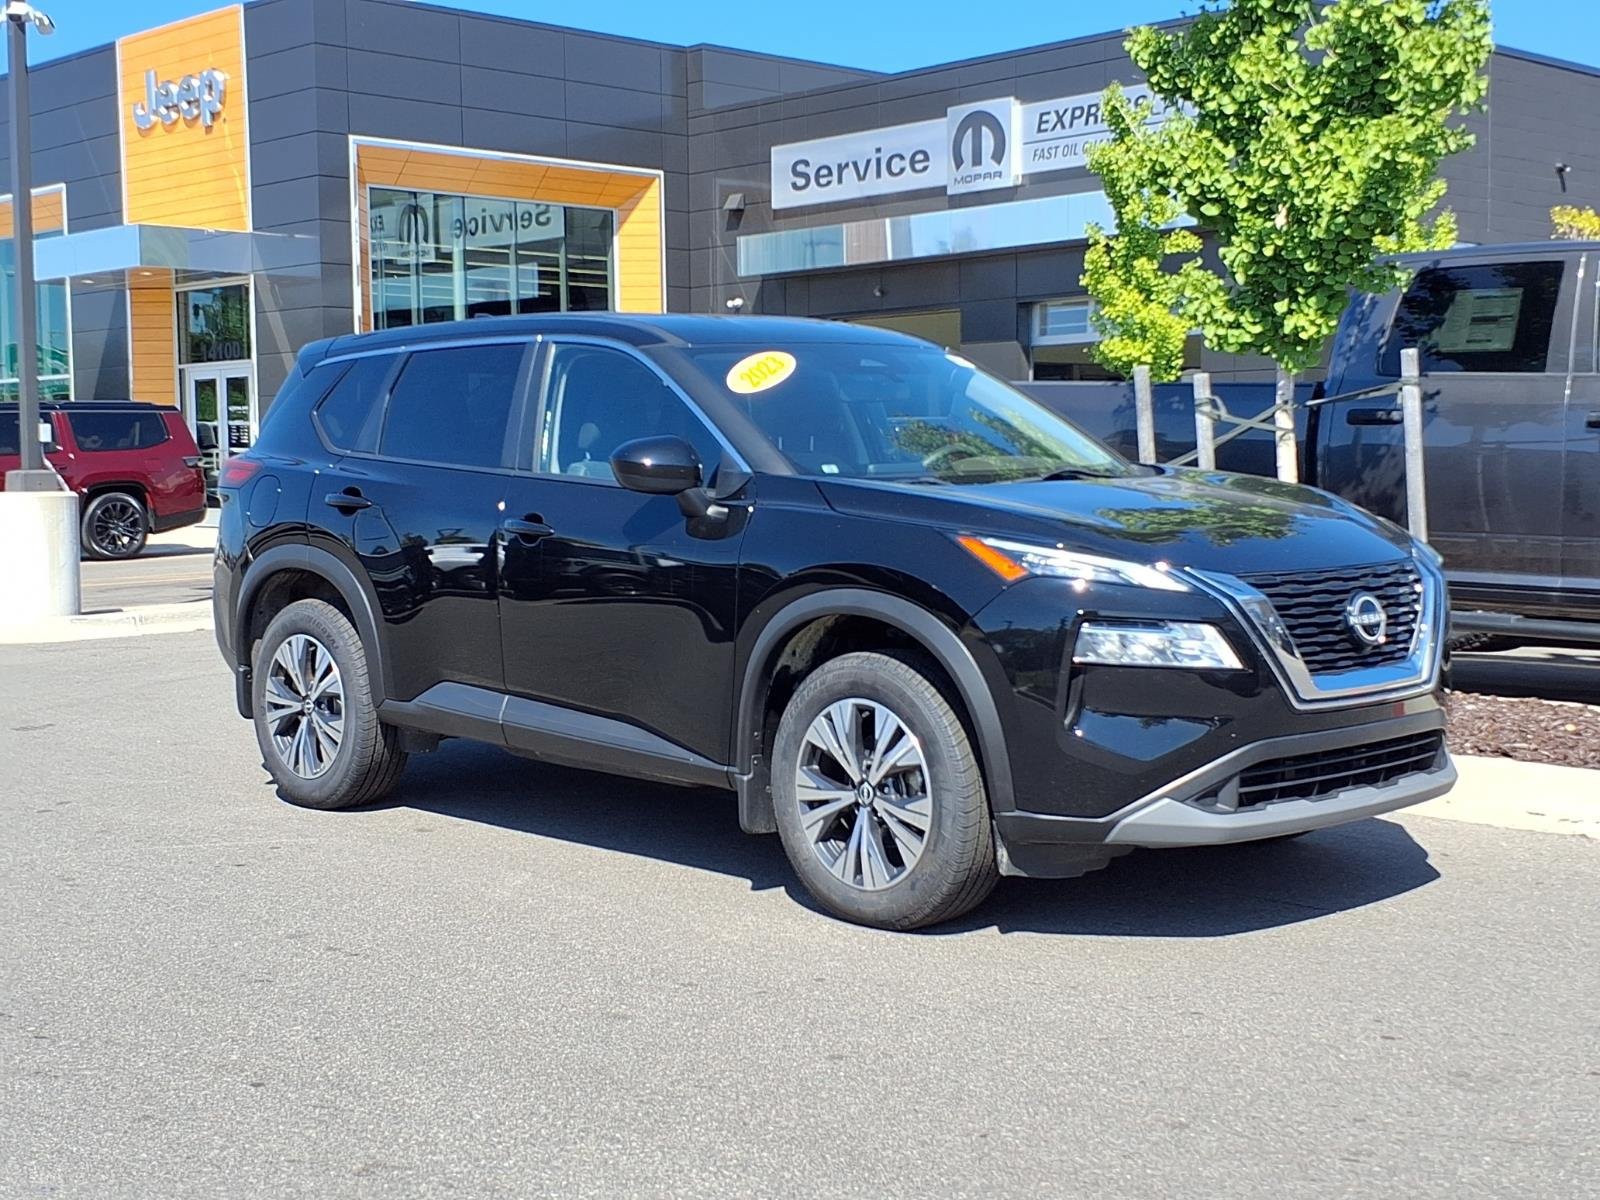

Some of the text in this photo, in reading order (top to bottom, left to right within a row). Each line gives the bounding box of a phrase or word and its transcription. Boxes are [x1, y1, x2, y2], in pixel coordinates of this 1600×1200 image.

[133, 68, 225, 129] Jeep
[1036, 95, 1148, 134] EXPR
[1032, 145, 1059, 161] FAST
[1062, 143, 1079, 158] OIL
[790, 147, 930, 191] Service
[954, 170, 1003, 186] MOPAR
[200, 340, 241, 361] 14100
